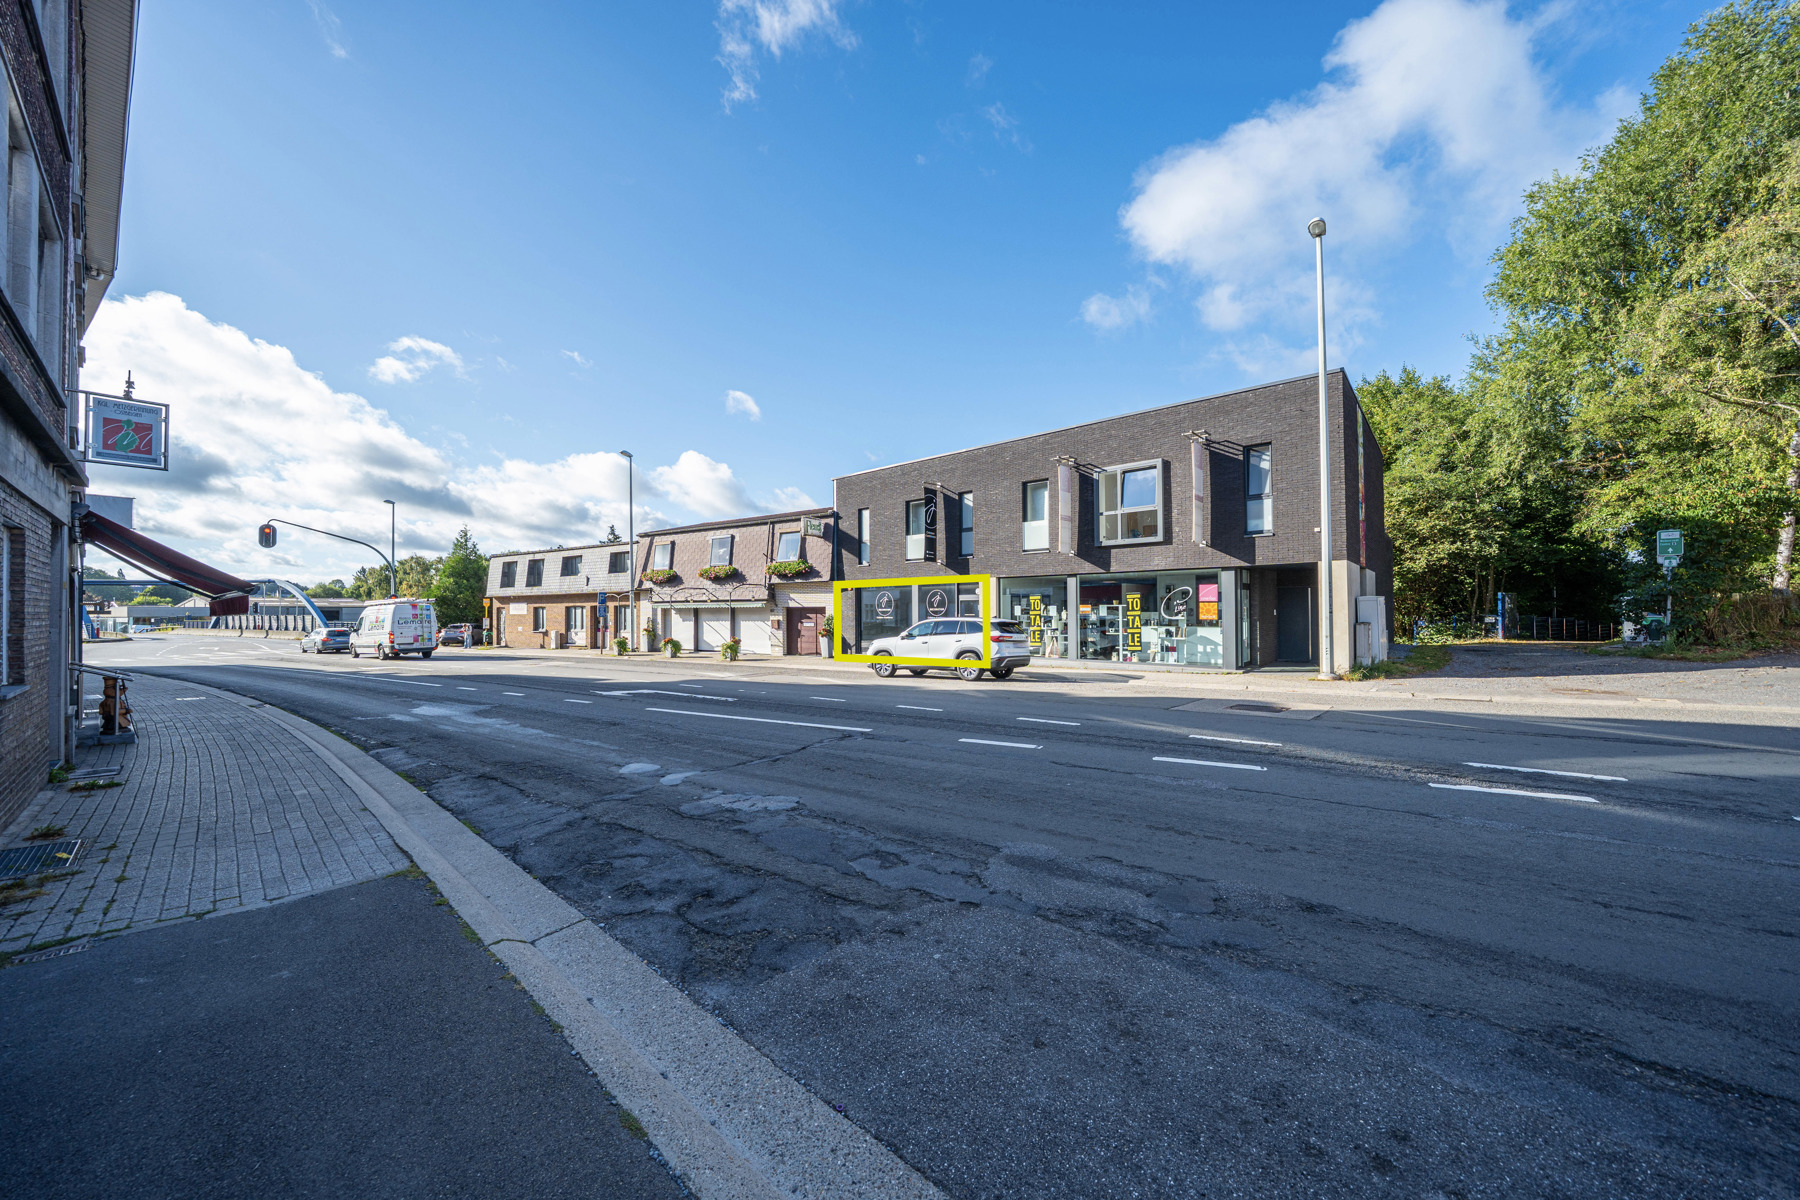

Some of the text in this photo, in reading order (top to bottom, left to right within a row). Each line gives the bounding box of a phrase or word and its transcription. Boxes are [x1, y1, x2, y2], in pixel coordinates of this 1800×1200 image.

[1030, 599, 1041, 610] TO
[1127, 598, 1141, 610] TO
[1030, 615, 1041, 626] TA
[1127, 616, 1141, 628] TA
[1030, 631, 1041, 642] LE
[1128, 634, 1141, 646] LE
